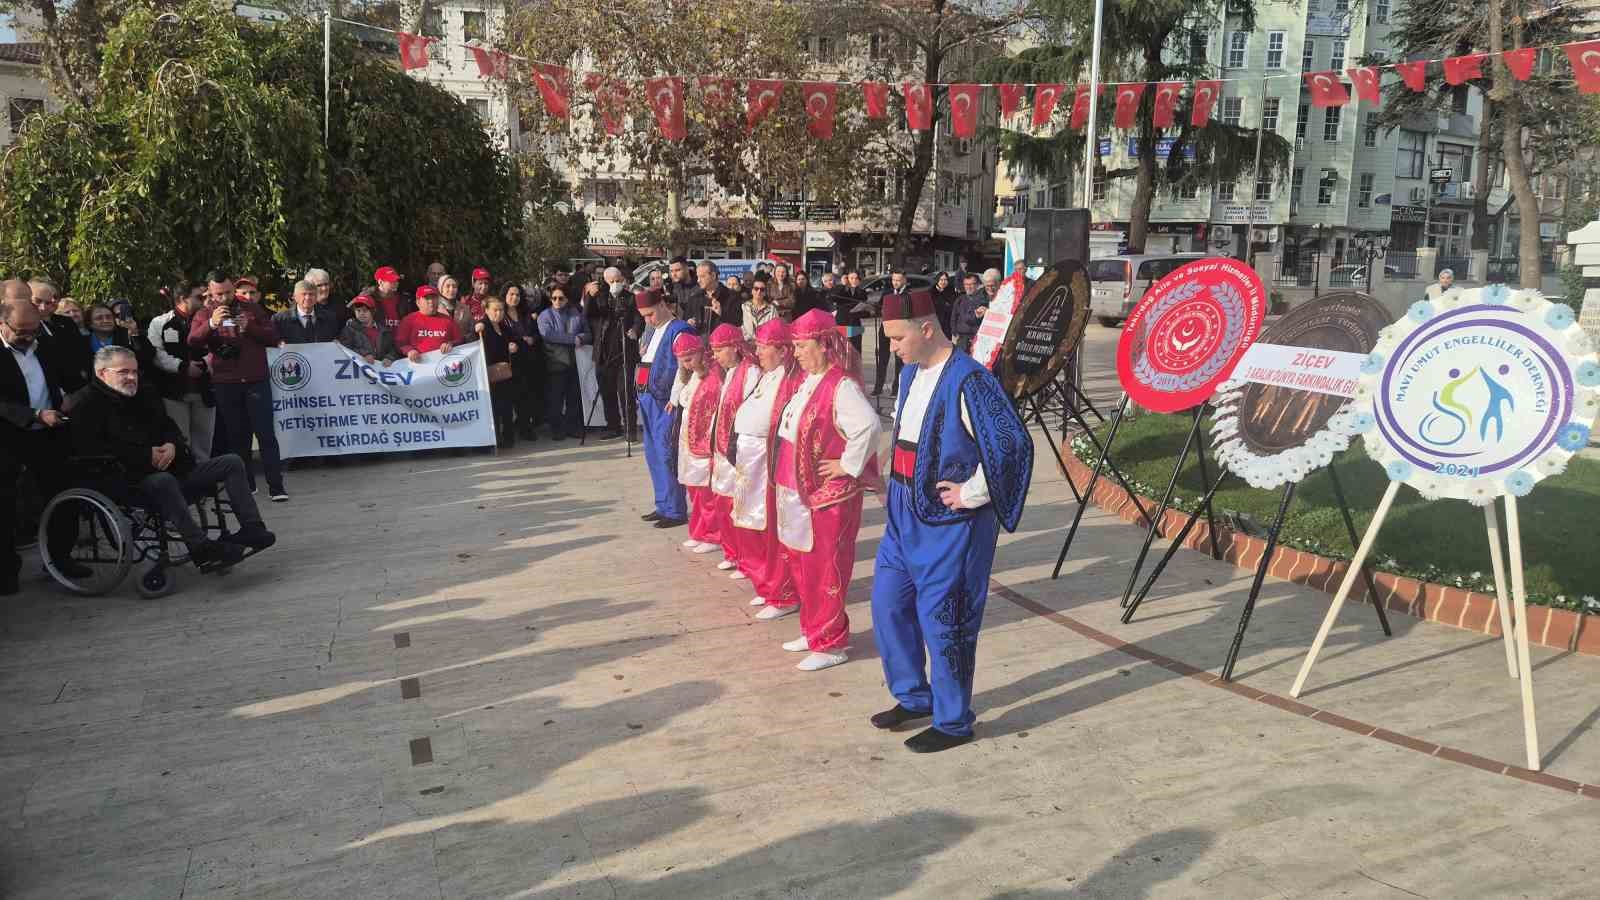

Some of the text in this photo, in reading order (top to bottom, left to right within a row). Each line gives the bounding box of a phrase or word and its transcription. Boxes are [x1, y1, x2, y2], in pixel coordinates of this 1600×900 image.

[1155, 280, 1172, 295] Aile
[1186, 263, 1218, 275] Sosyal
[1220, 263, 1254, 289] Hizmetler
[1291, 352, 1336, 369] ZİÇEV
[1411, 345, 1440, 372] UMUT
[1443, 335, 1523, 359] ENGELLİLER
[273, 391, 479, 412] ZİHİNSEL YETERSİZ ÇOCUKLARI
[278, 410, 480, 432] YETİŞTİRME VE KORUMA VAKFI
[317, 427, 446, 448] TEKİRDAĞ ŞUBESİ
[1432, 462, 1479, 478] 2021
